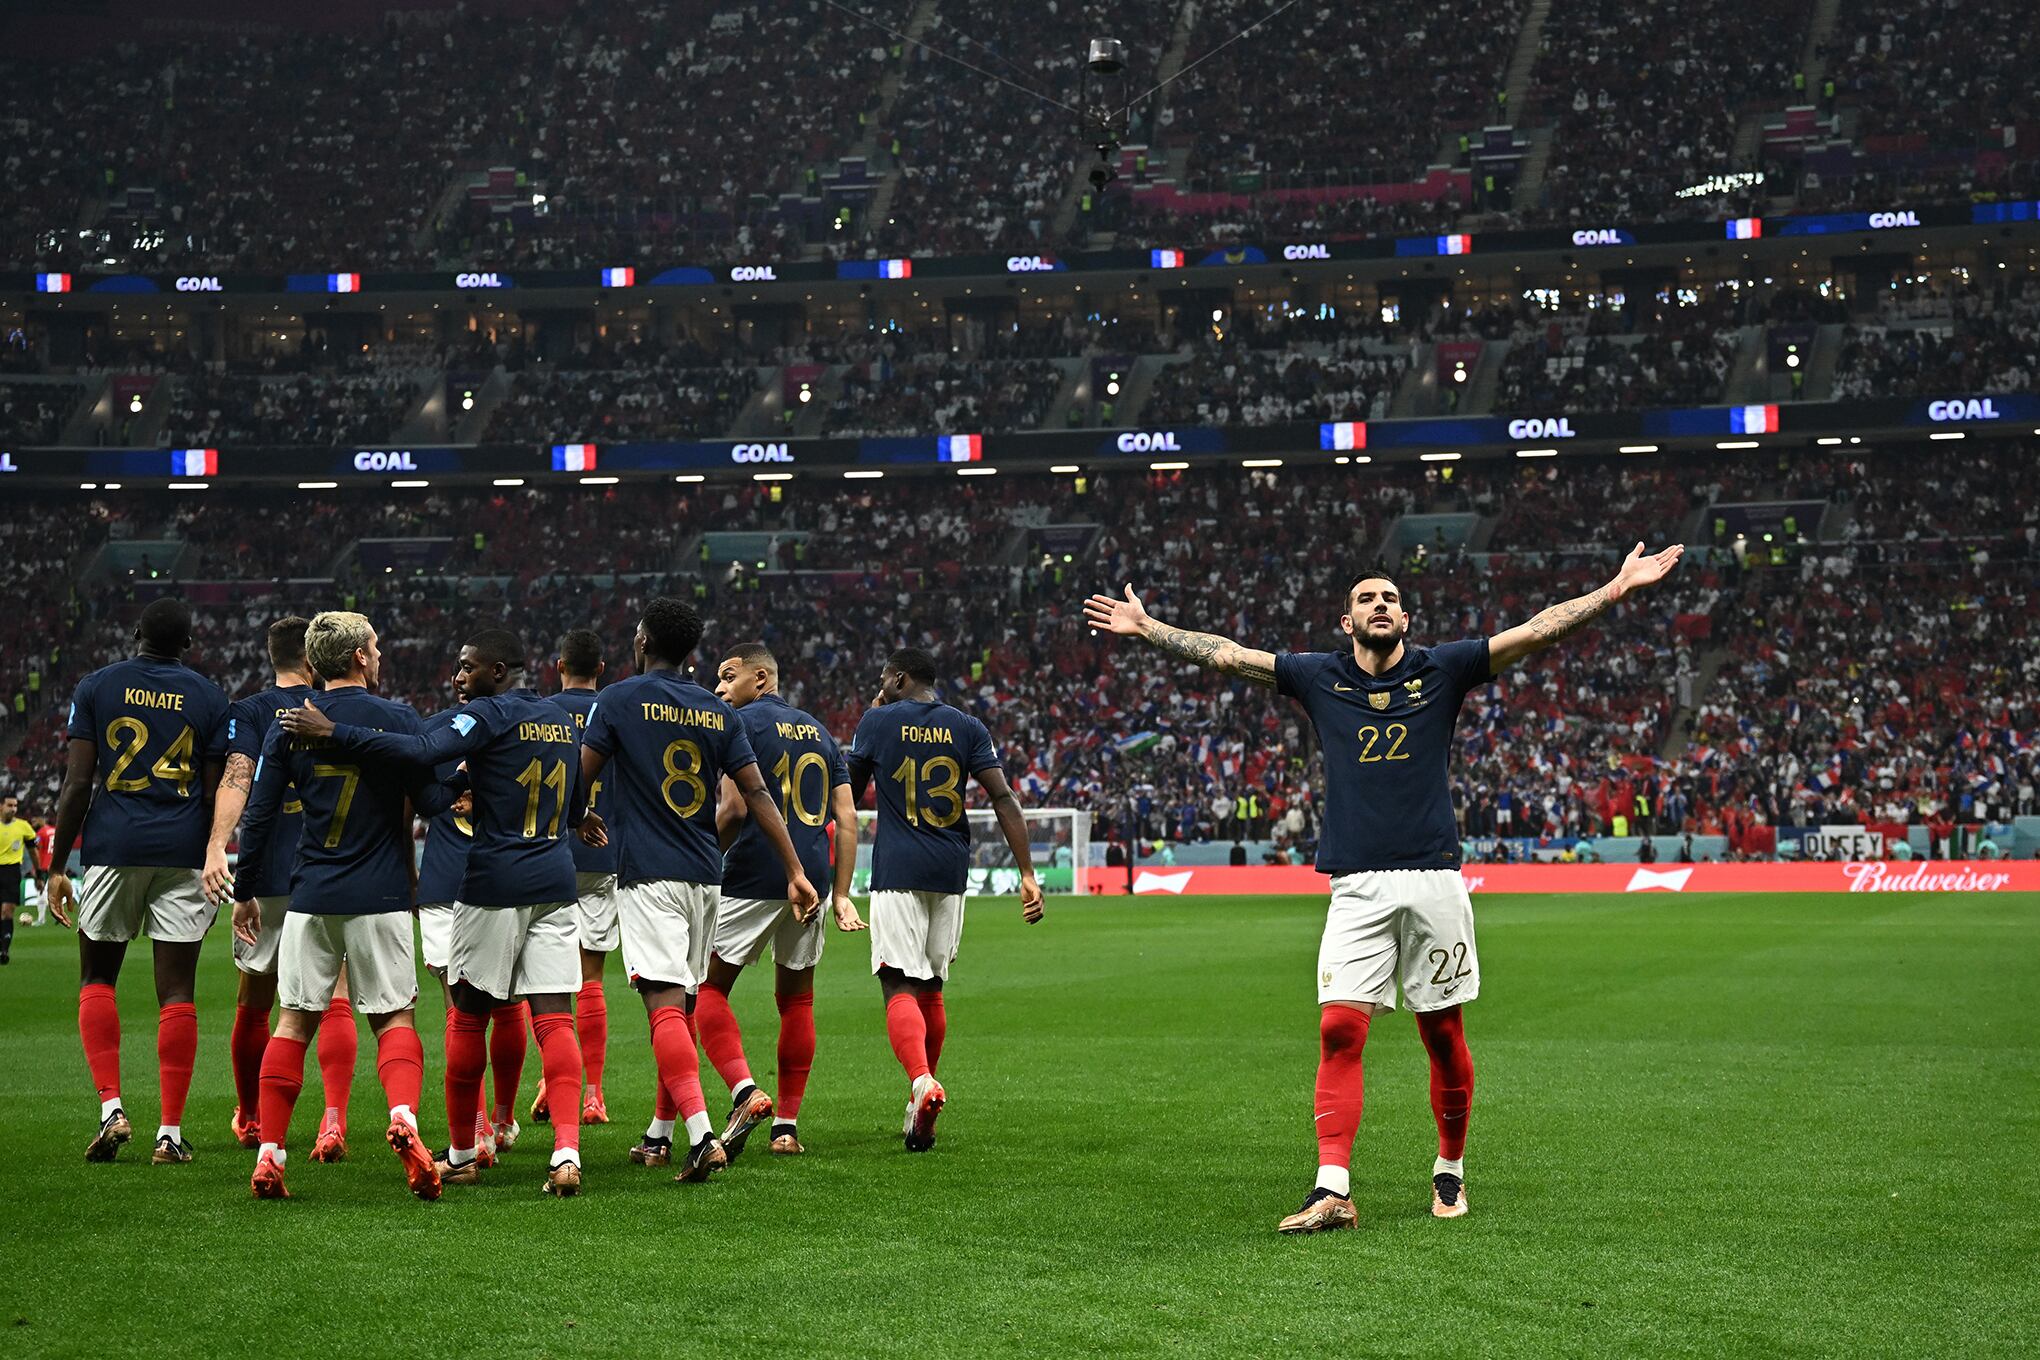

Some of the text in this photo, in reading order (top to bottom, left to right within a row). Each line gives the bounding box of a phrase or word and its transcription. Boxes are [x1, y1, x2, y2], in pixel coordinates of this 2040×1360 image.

[1869, 211, 1920, 228] GOAL
[1573, 229, 1621, 245] GOAL
[1284, 244, 1330, 260] GOAL
[176, 277, 222, 291] GOAL
[456, 273, 501, 287] GOAL
[731, 266, 776, 281] GOAL
[1929, 399, 1999, 420] GOAL
[1509, 418, 1575, 439] GOAL
[1117, 432, 1181, 452] GOAL
[354, 452, 417, 471] GOAL
[732, 444, 794, 463] GOAL
[124, 688, 184, 712] KONATE
[519, 722, 573, 744] DEMBELE
[902, 725, 953, 745] FOFANA
[1358, 723, 1410, 763] 22
[106, 717, 195, 797] 24
[661, 739, 706, 819] 8
[771, 750, 829, 826] 10
[515, 756, 567, 840] 11
[892, 756, 964, 829] 13
[313, 764, 360, 848] 7
[1843, 862, 2010, 892] Budweiser
[1429, 942, 1472, 985] 22
